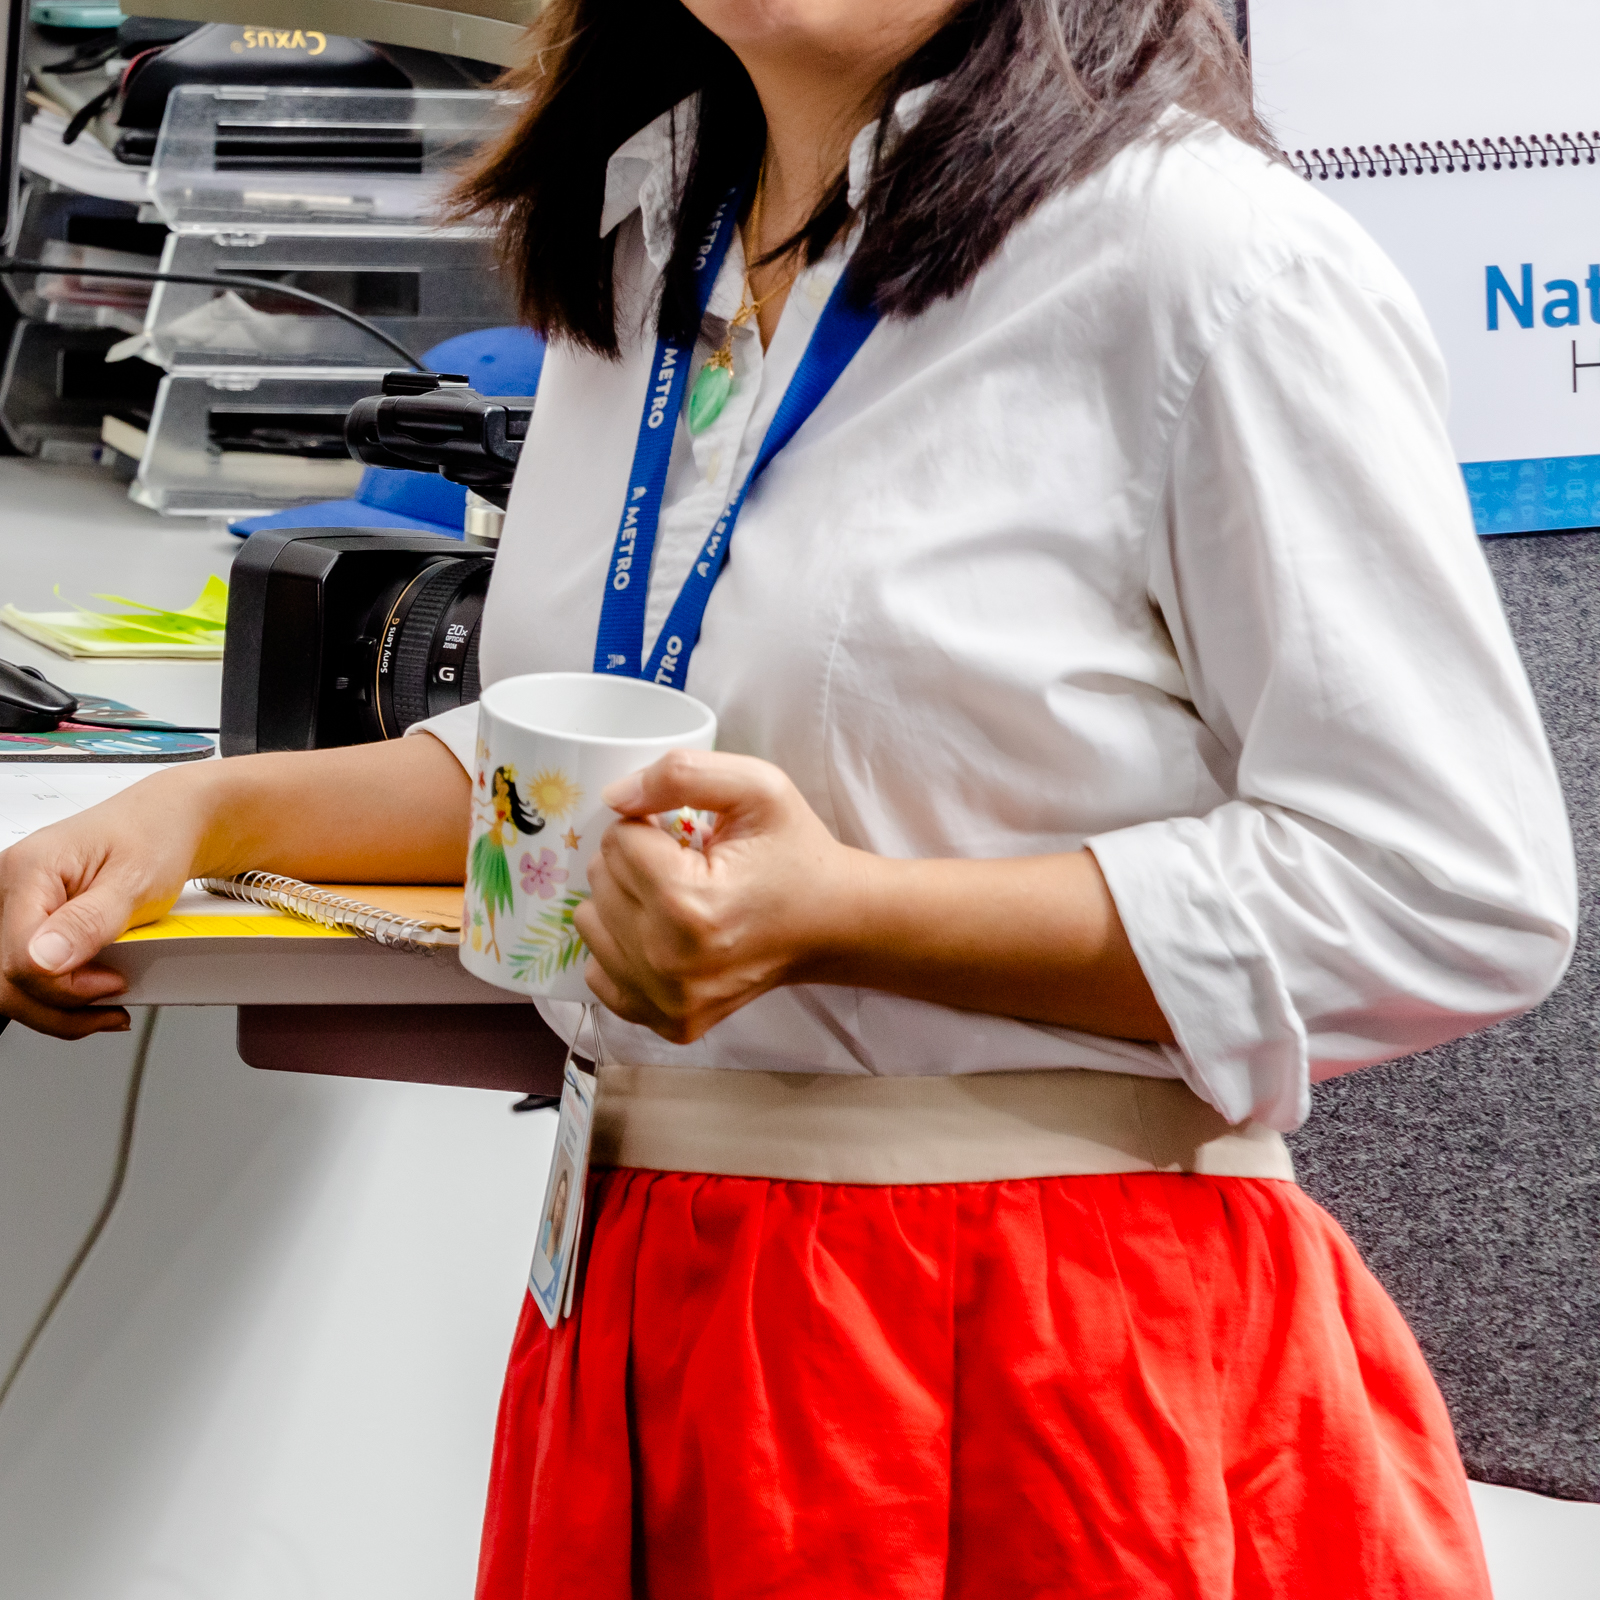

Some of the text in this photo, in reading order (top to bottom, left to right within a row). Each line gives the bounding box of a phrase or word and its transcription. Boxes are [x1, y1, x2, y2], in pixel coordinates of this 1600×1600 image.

[647, 347, 679, 429] METRO
[612, 506, 640, 591] METRO
[380, 617, 400, 674] Sony Lens G
[442, 642, 458, 650] ZOOM
[445, 635, 465, 644] OPTICAL
[447, 623, 468, 637] 20x
[438, 666, 455, 682] G
[653, 635, 683, 685] TRO
